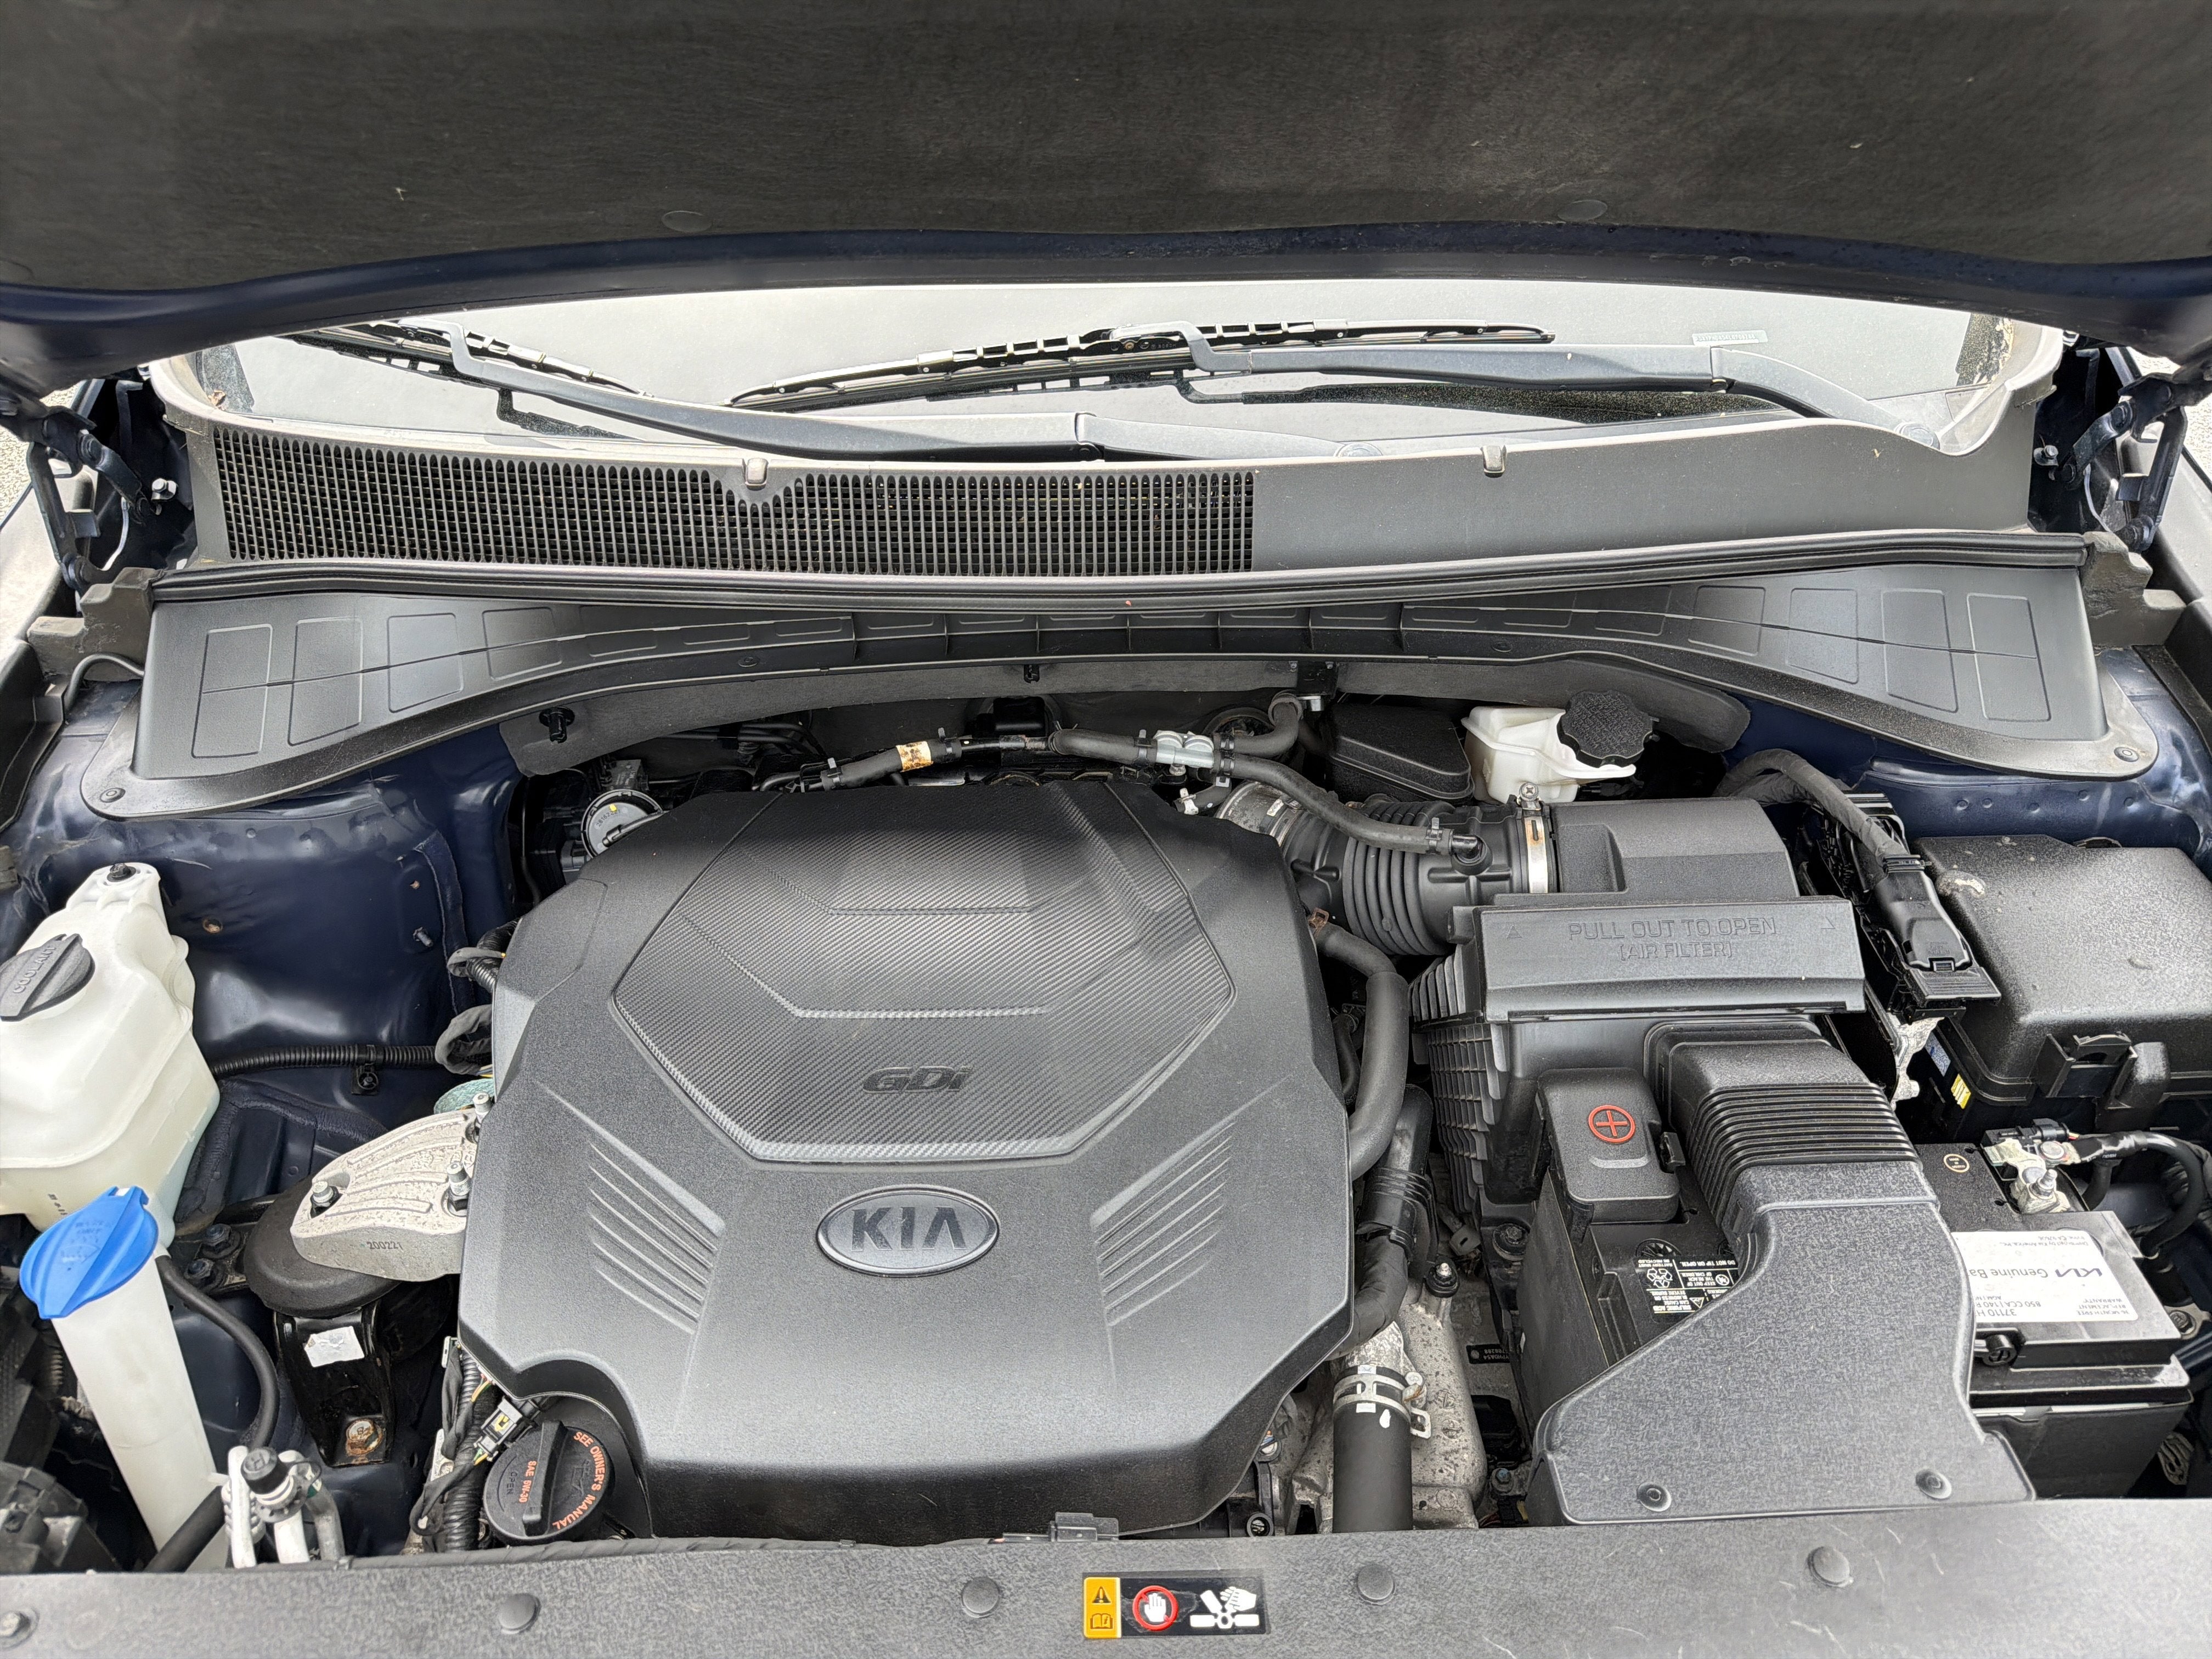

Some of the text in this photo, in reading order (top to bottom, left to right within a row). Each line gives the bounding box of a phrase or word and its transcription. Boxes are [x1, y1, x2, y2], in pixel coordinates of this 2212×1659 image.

[1568, 917, 1776, 940] PULL OUT TO OPEN
[13, 945, 57, 994] COOLANT
[366, 1241, 404, 1251] 200221
[851, 1207, 967, 1252] KIA
[1990, 1268, 2049, 1278] Genuine
[1988, 1309, 2017, 1317] 37110
[518, 1460, 537, 1503] SAE 5W-30
[552, 1431, 605, 1530] SEE OWNER'S MANUAL
